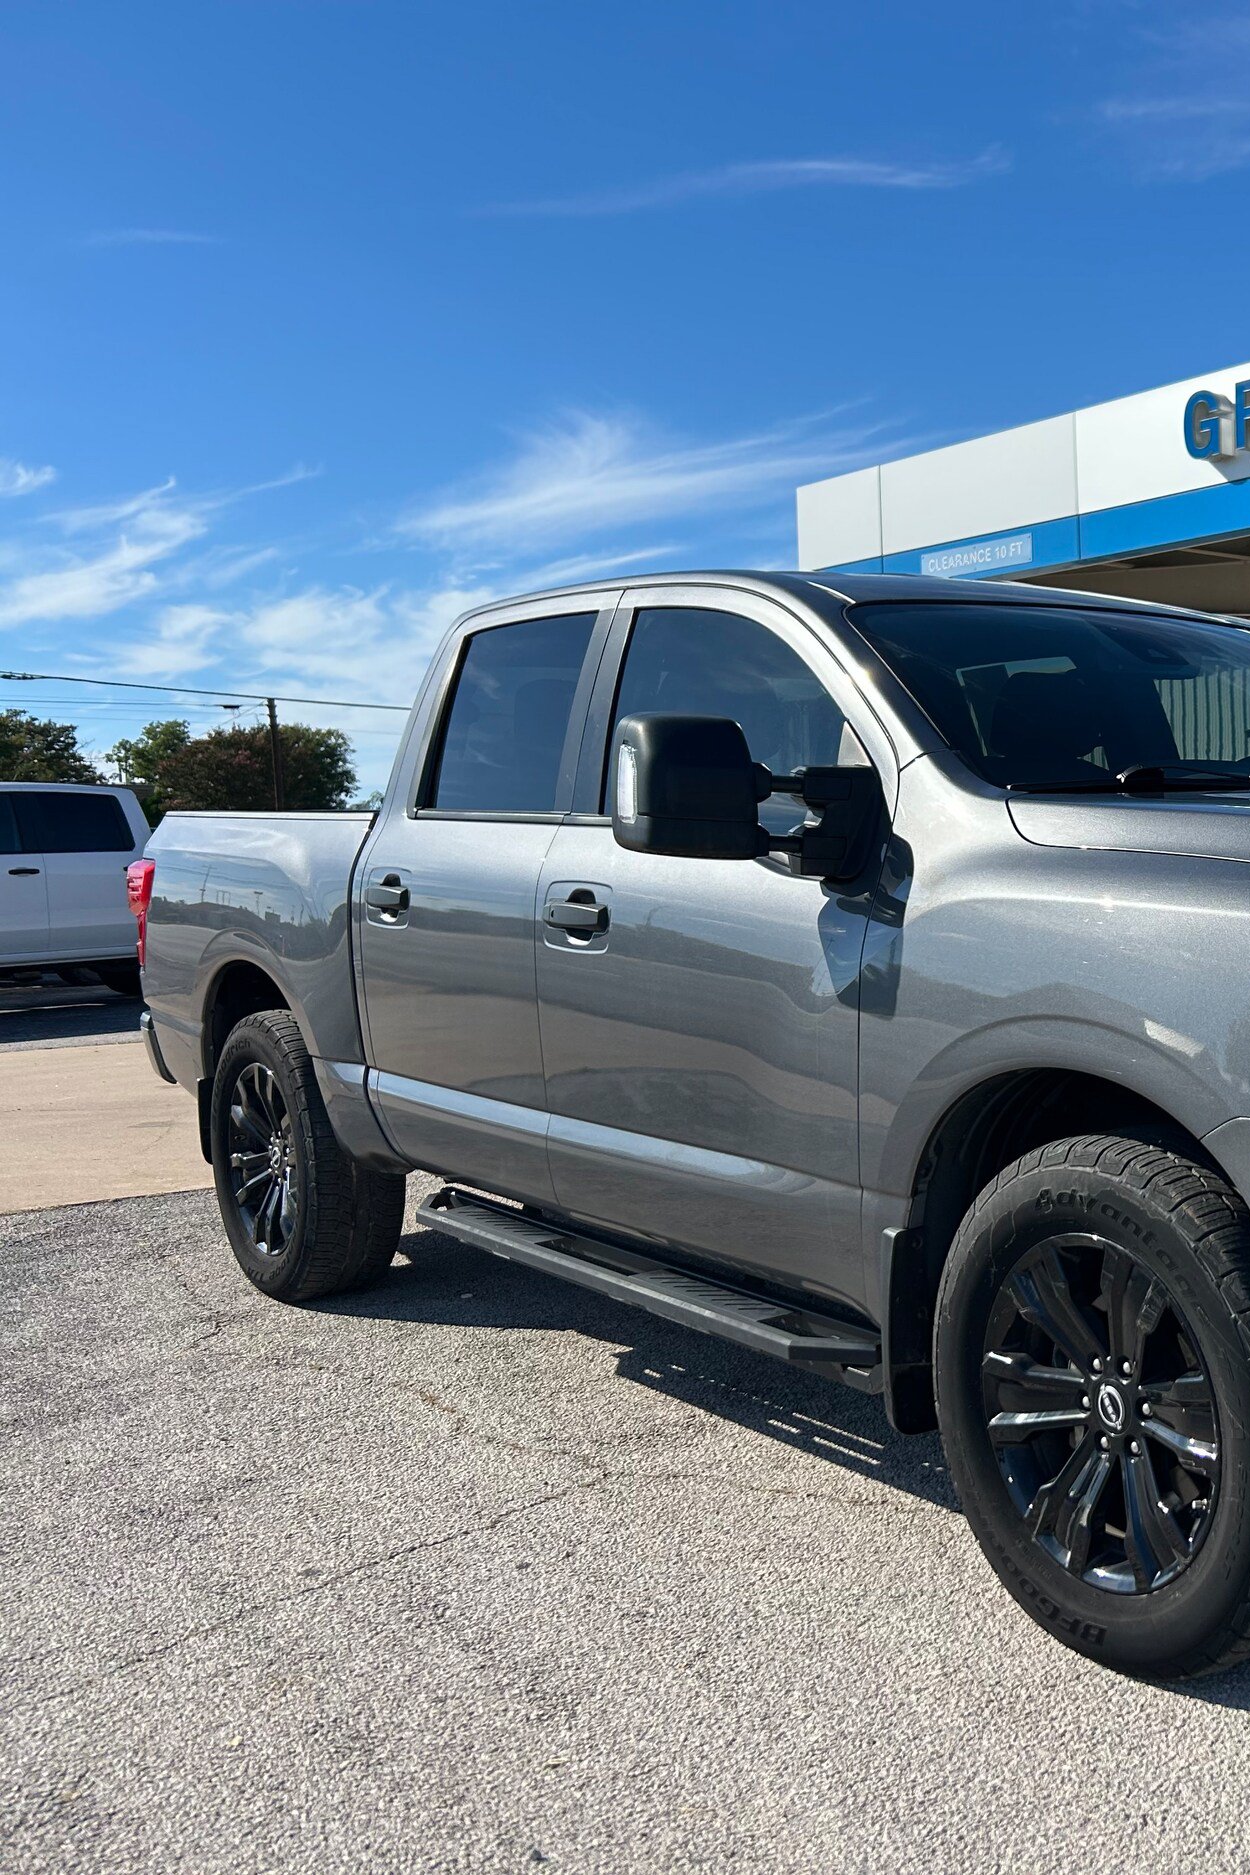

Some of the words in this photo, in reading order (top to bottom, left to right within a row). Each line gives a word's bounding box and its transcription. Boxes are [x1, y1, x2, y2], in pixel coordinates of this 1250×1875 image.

[928, 549, 992, 573] CLEARANCE
[995, 545, 1006, 560] 10
[1009, 541, 1024, 557] FT
